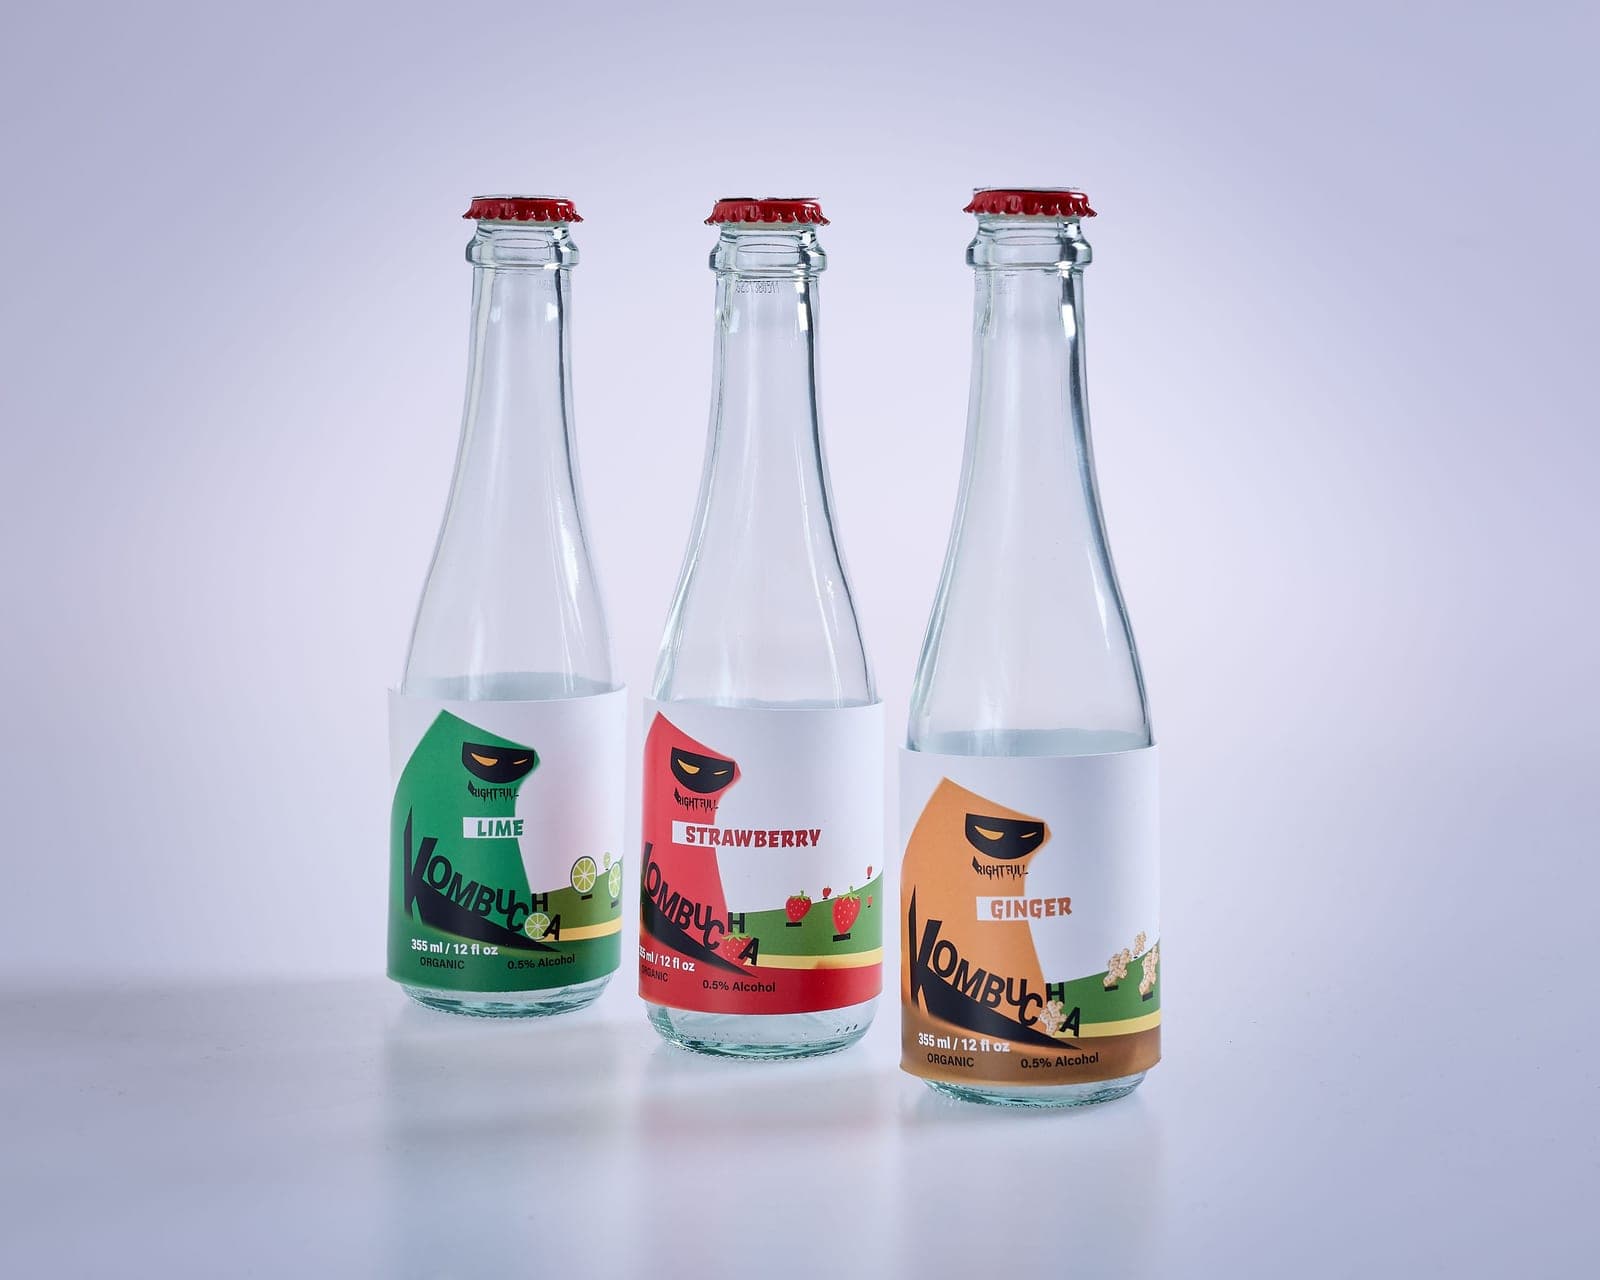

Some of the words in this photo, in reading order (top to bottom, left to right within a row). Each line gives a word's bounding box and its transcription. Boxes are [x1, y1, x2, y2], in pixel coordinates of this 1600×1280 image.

[477, 819, 524, 837] LIME
[686, 825, 821, 848] STRAWBERRY
[991, 897, 1073, 919] GINGER
[411, 939, 428, 952] 355
[430, 941, 443, 954] ml
[445, 942, 451, 955] /
[453, 943, 467, 955] 12
[471, 943, 481, 956] fl
[483, 946, 498, 957] oz
[420, 957, 465, 970] ORGANIC
[507, 959, 535, 970] 0.5%
[538, 955, 575, 969] Alcohol
[646, 951, 654, 962] ml
[660, 955, 671, 968] 12
[673, 957, 680, 969] fl
[682, 961, 695, 972] oz
[703, 980, 729, 991] 0.5%
[733, 982, 776, 993] Alcohol
[918, 1033, 935, 1047] 355
[937, 1035, 950, 1049] ml
[952, 1037, 958, 1050] /
[961, 1038, 976, 1051] 12
[980, 1039, 991, 1052] fl
[994, 1042, 1010, 1053] oz
[927, 1053, 974, 1068] ORGANIC
[1021, 1057, 1052, 1069] 0.5%
[1055, 1053, 1099, 1068] Alcohol
